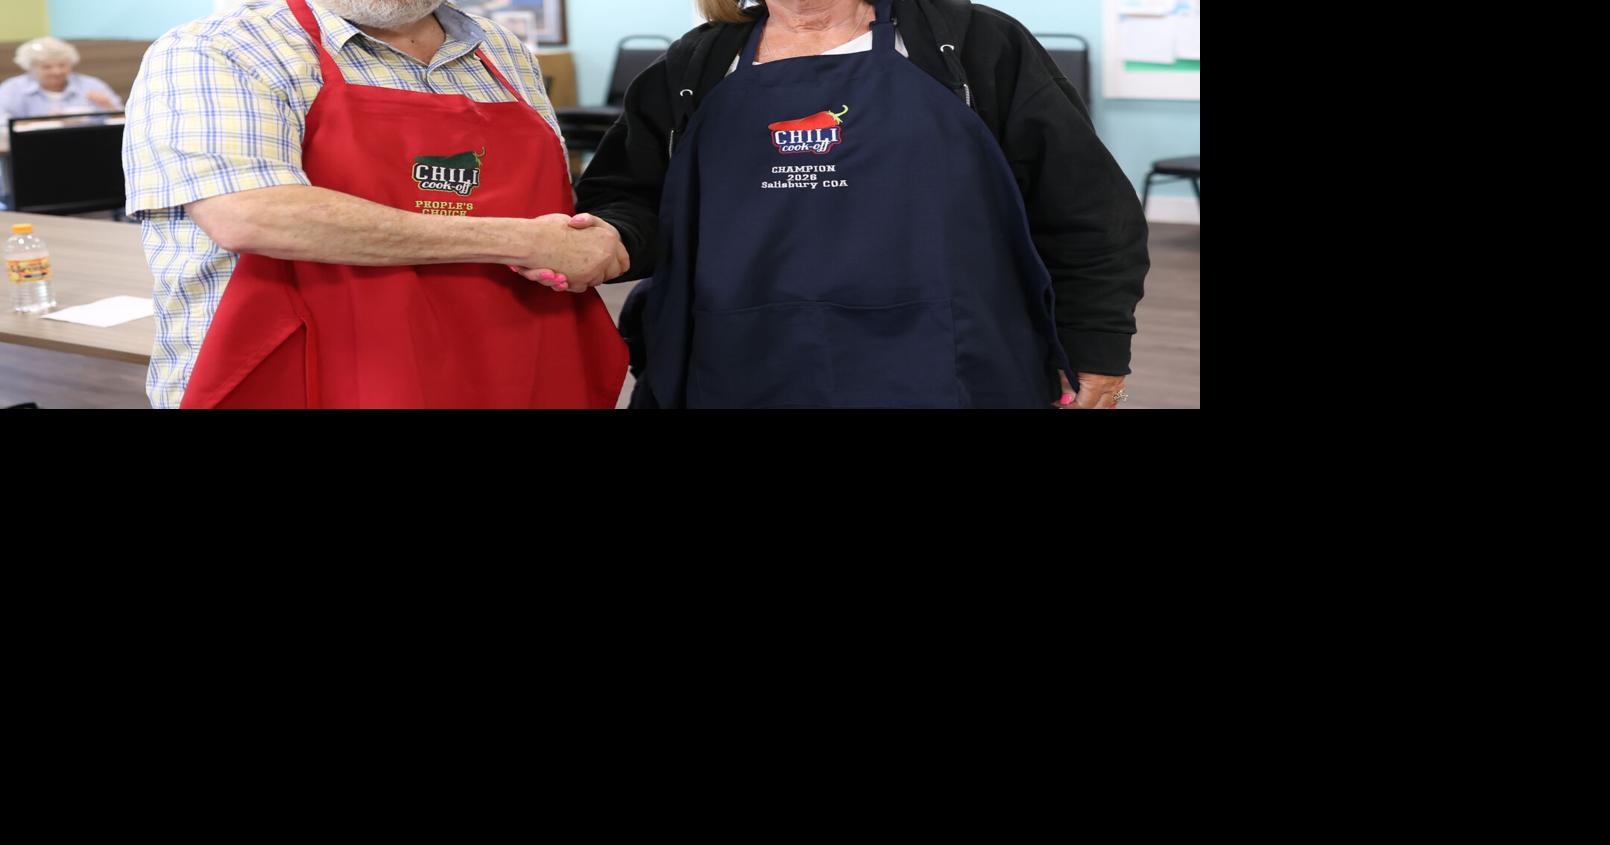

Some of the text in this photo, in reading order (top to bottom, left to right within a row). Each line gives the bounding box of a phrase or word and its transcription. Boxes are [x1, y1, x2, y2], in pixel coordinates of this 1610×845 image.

[775, 128, 838, 145] CHILI
[782, 140, 830, 152] cook-off
[415, 164, 478, 185] CHILI
[771, 165, 836, 174] CHAMPION
[421, 181, 471, 194] cook-off
[761, 180, 848, 189] Salisbury COA
[415, 200, 474, 211] PEOPLE'S
[422, 208, 467, 217] CHOICE
